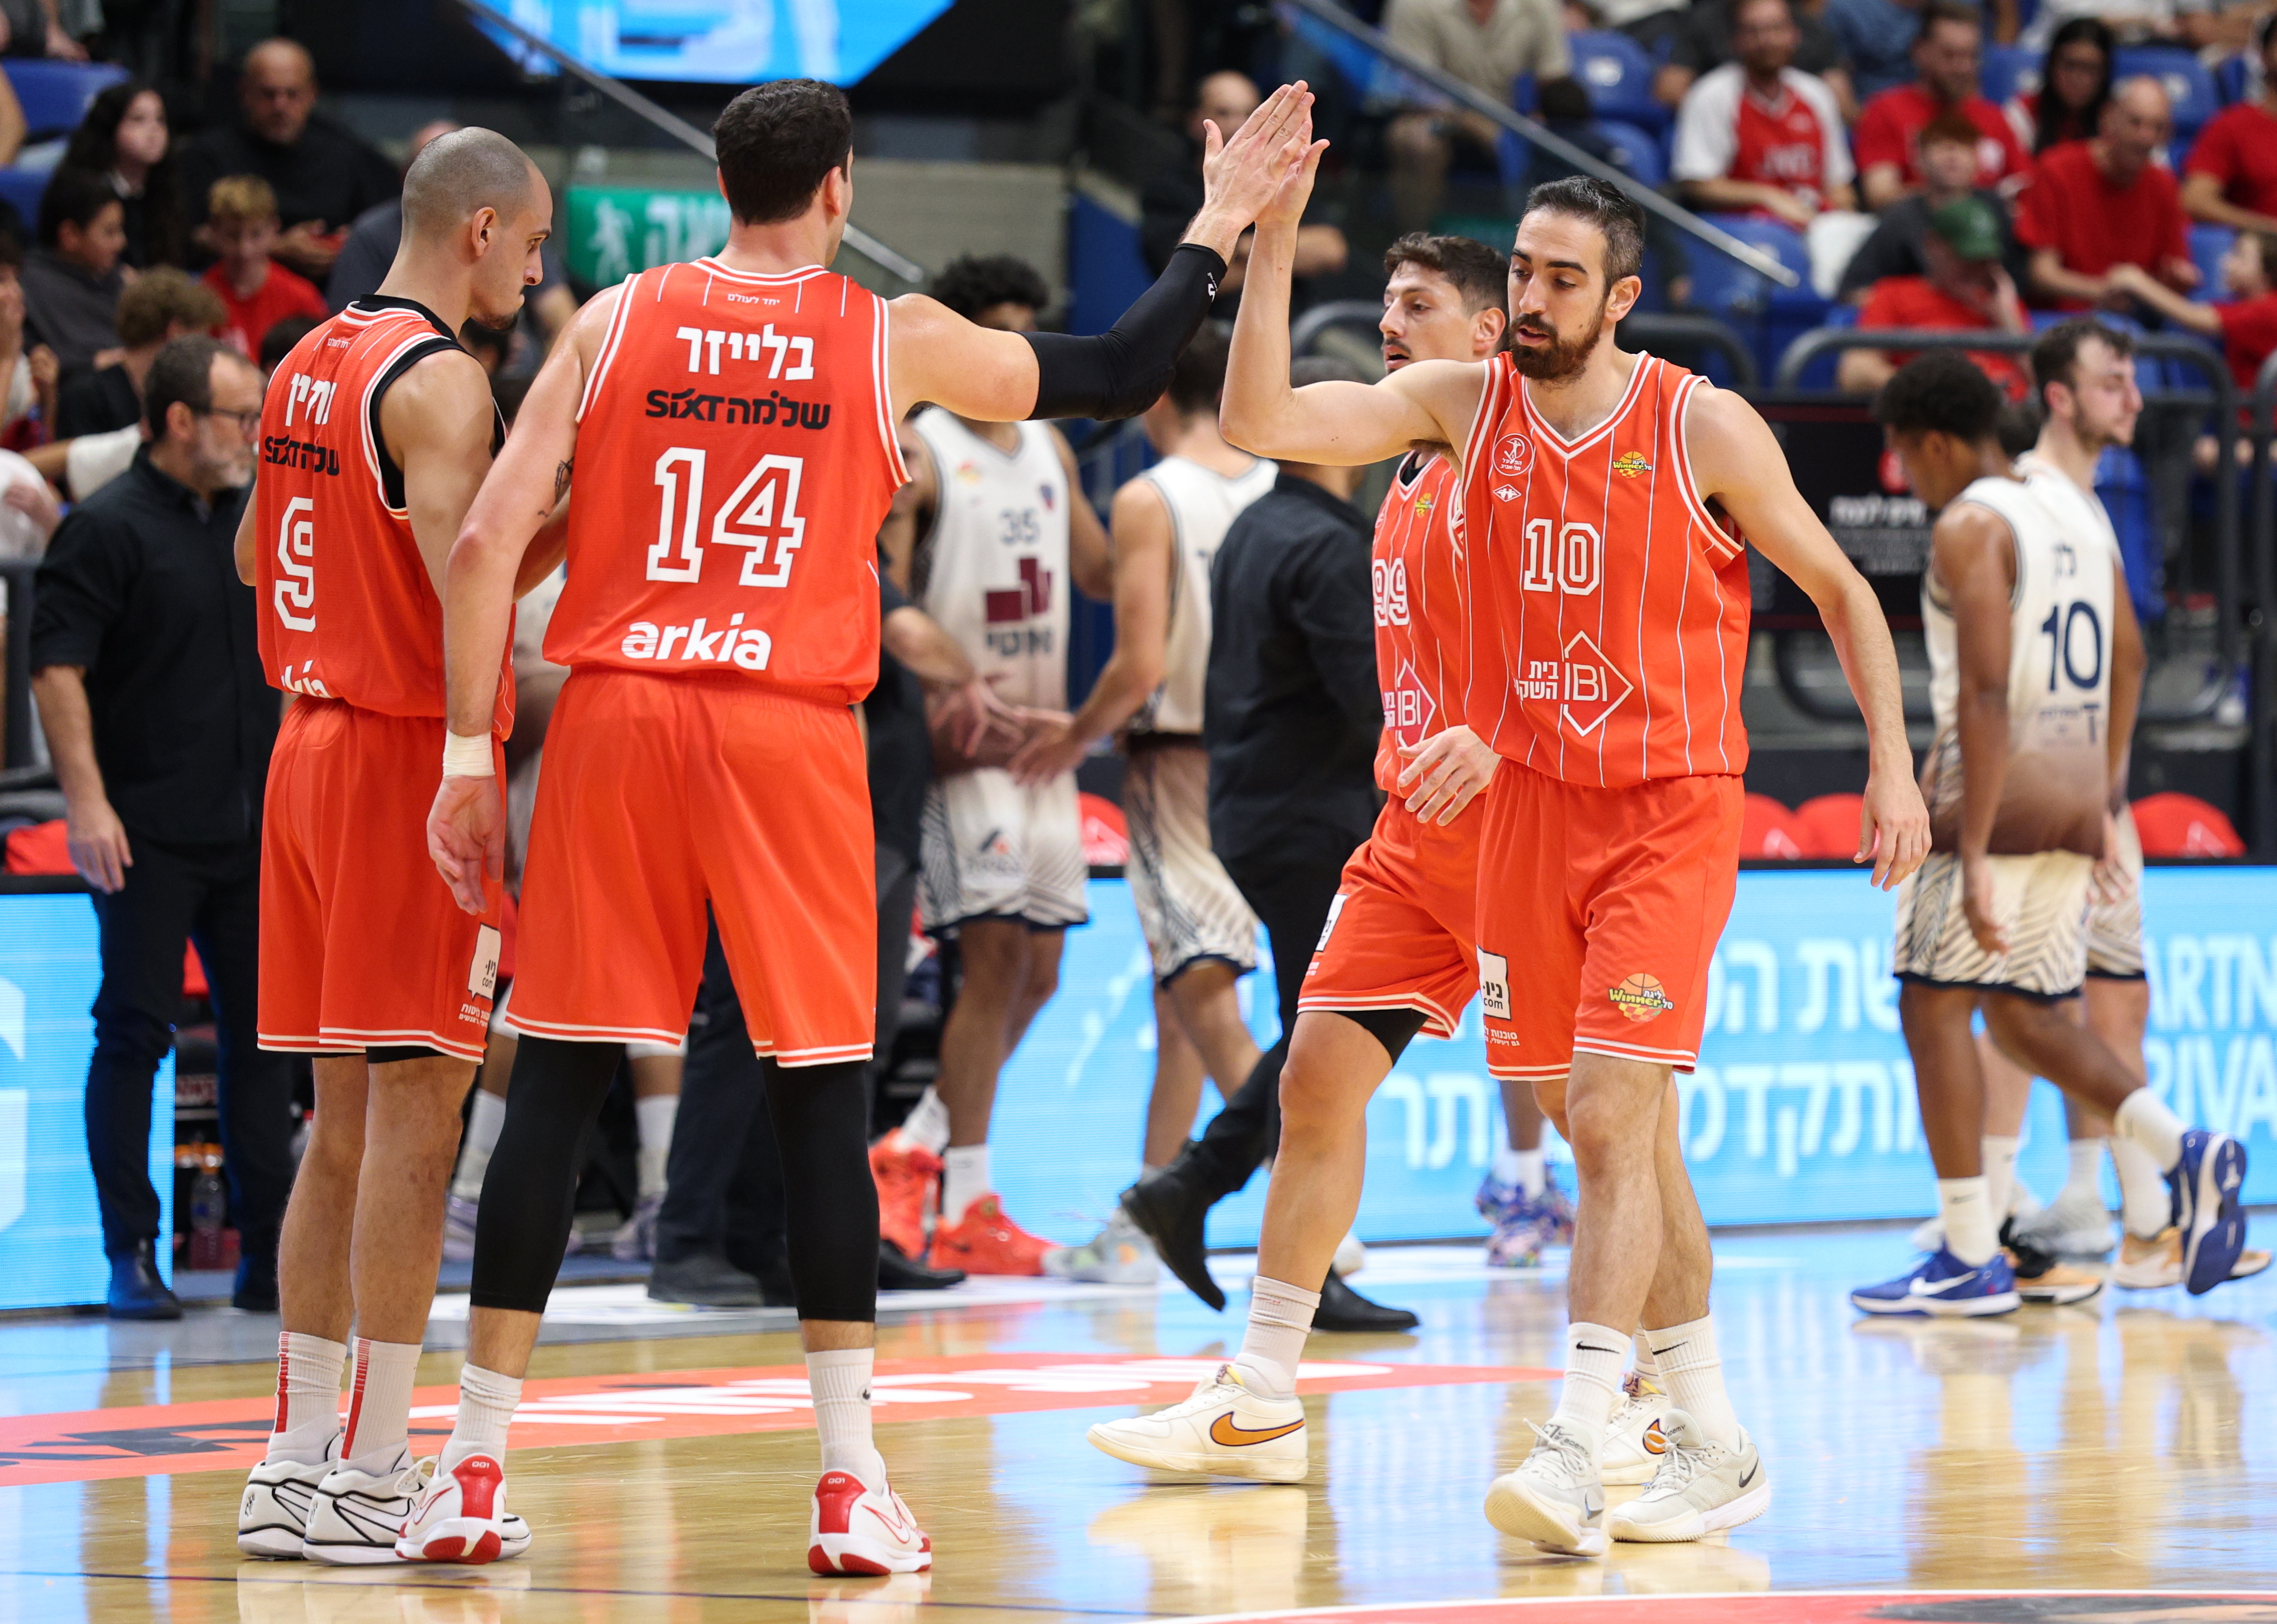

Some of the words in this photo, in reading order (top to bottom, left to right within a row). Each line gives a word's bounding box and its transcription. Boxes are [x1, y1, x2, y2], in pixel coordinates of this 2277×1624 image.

[728, 293, 759, 303] לעולם
[676, 324, 814, 381] בלייזר
[646, 447, 806, 588] 14
[999, 508, 1040, 545] 35
[274, 496, 316, 633] 9
[1523, 518, 1601, 596] 10
[1372, 557, 1410, 627] 99
[622, 613, 772, 670] arkia
[2042, 601, 2101, 694] 10
[1528, 661, 1559, 679] בית
[1564, 662, 1608, 702] IBI
[1397, 689, 1422, 727] IBI
[1484, 998, 1503, 1010] com
[1609, 988, 1662, 1007] Winner
[1663, 998, 1673, 1010] סל
[1643, 990, 1662, 1000] ליגת
[1490, 1029, 1518, 1040] סוכנות
